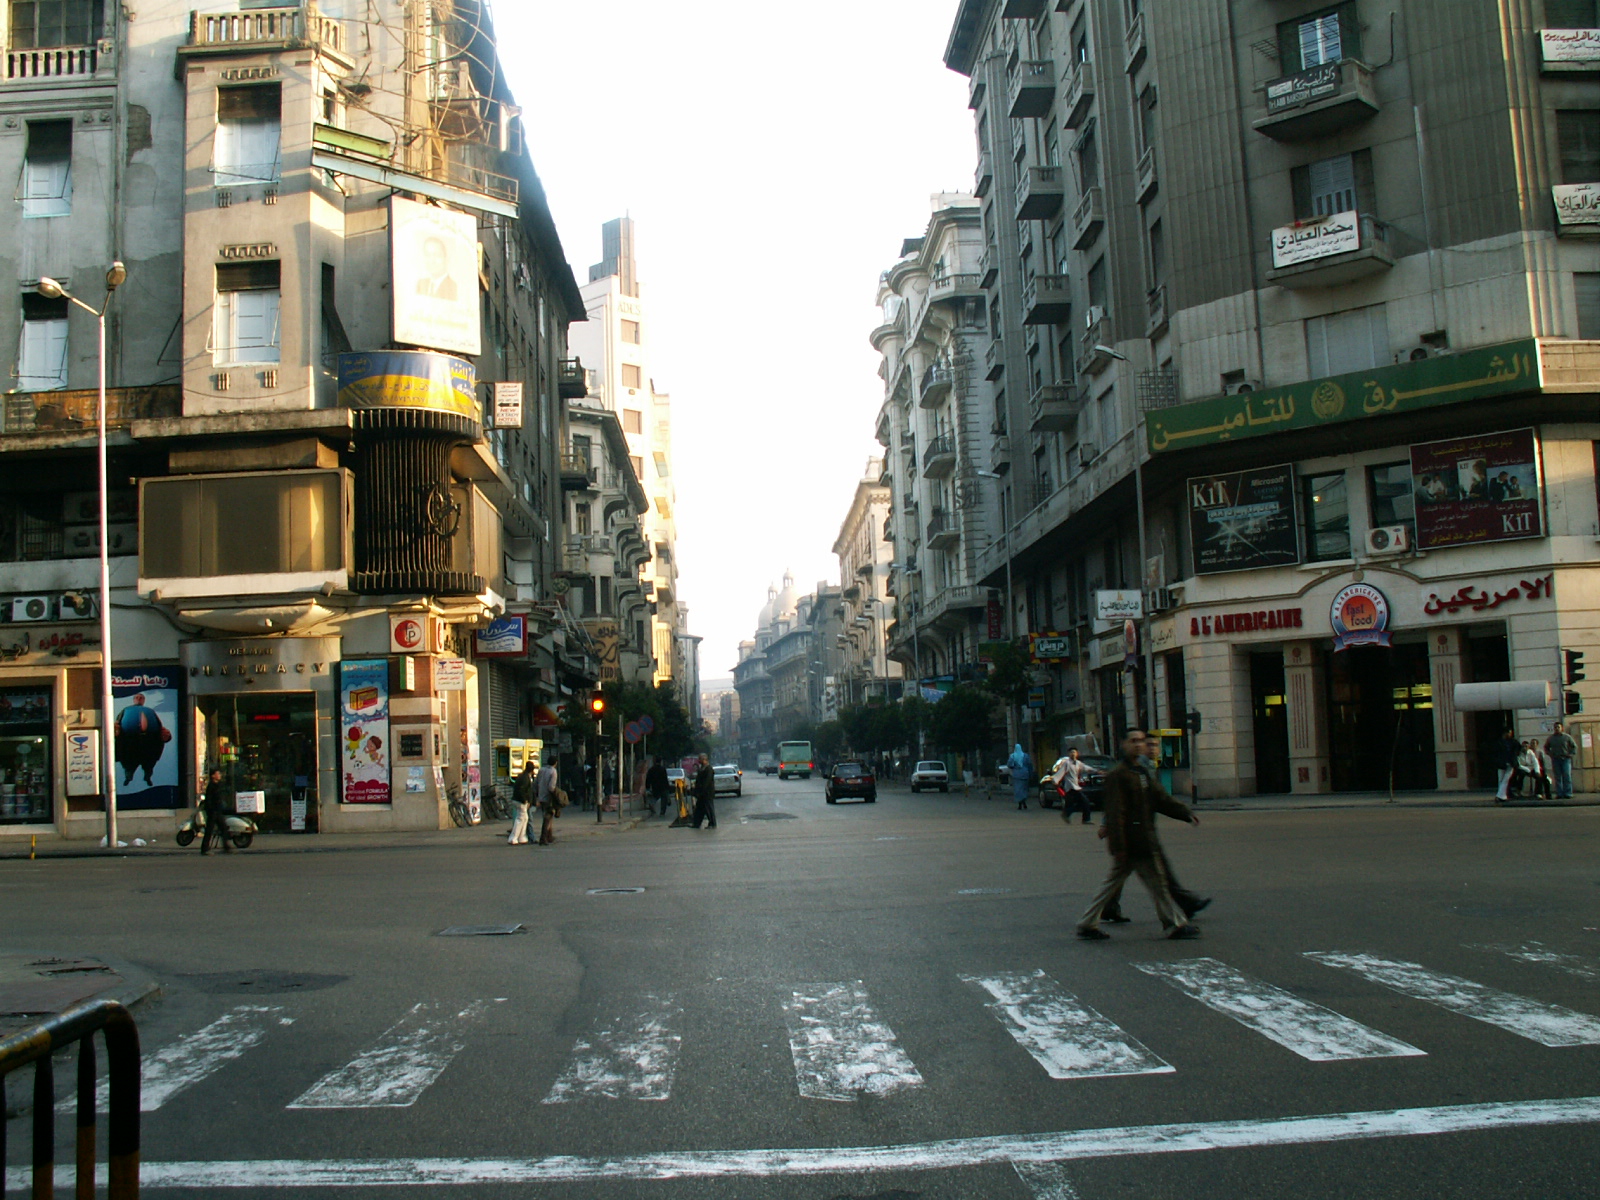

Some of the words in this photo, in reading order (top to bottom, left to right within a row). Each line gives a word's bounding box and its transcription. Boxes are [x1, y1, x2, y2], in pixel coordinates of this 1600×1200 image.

[1362, 353, 1531, 414] الشرق
[1151, 394, 1296, 450] للتأمين
[1351, 615, 1372, 627] food
[190, 662, 325, 677] PHARMACY
